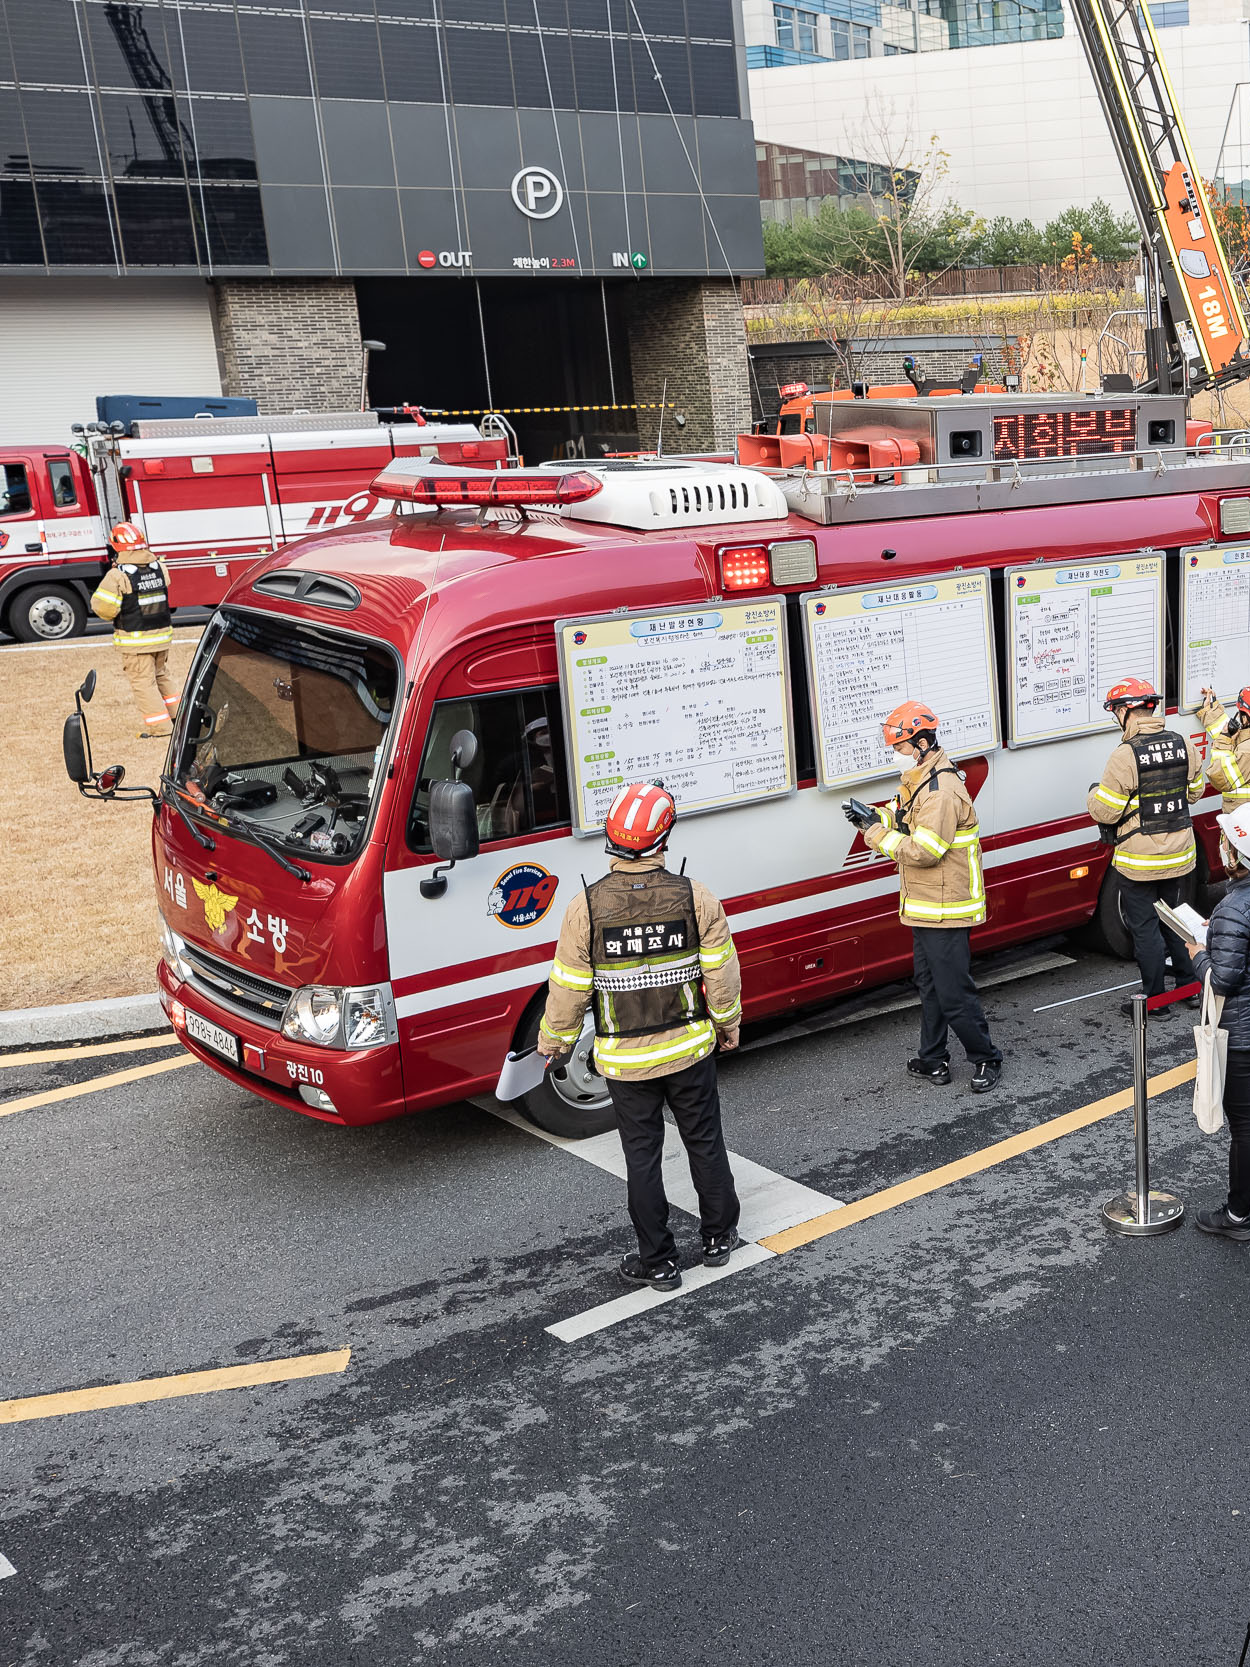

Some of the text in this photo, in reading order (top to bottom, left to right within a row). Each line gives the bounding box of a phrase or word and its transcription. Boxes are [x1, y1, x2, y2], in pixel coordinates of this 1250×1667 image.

[526, 176, 551, 210] P
[439, 251, 472, 268] OUT
[512, 256, 575, 269] 제한높이 2.3M
[612, 252, 629, 267] IN
[1197, 284, 1228, 340] 18M
[993, 409, 1135, 459] 지휘본부
[306, 494, 379, 529] 119
[955, 579, 981, 591] 광진소방서
[877, 589, 921, 604] 재난대응활동
[744, 608, 776, 619] 광진소방서
[648, 616, 704, 632] 재난발생현황
[1139, 749, 1186, 765] 화재조사
[500, 866, 543, 886] Seoul Fire Services
[503, 875, 559, 912] 119
[164, 866, 289, 954] 서울 소방
[512, 911, 537, 923] 서울소방
[622, 924, 666, 938] 서울소방
[605, 932, 684, 956] 화재조사
